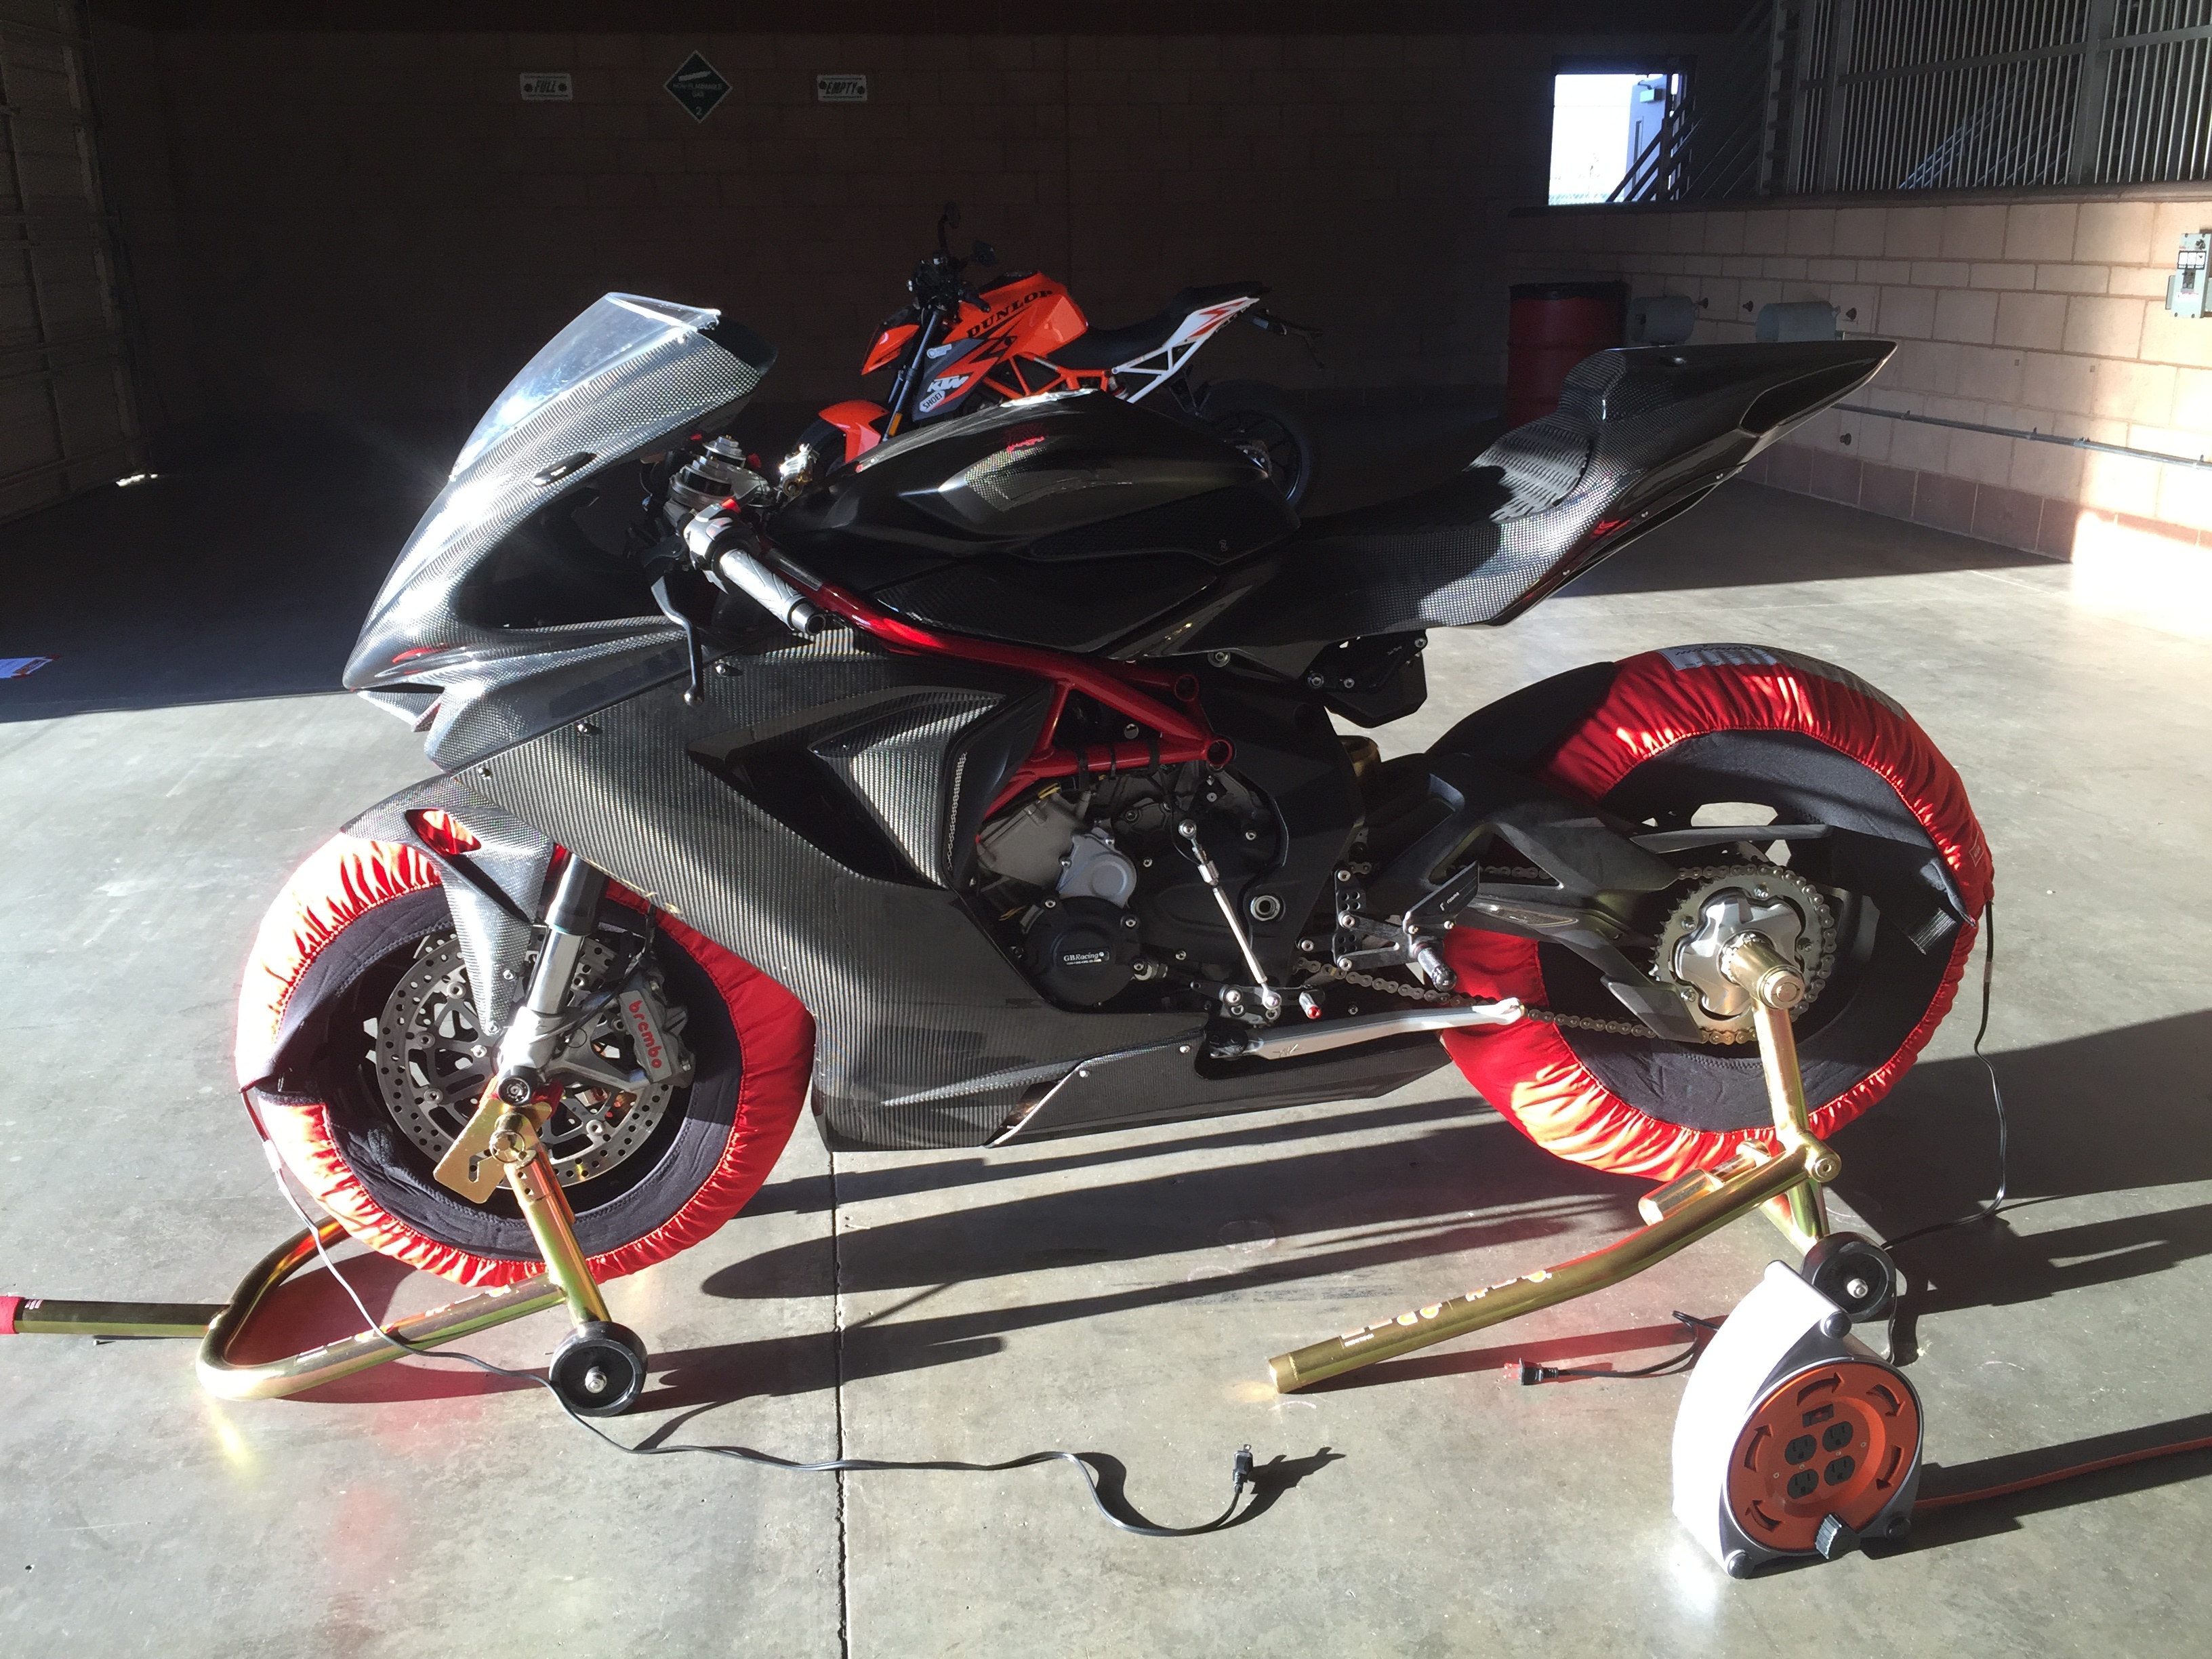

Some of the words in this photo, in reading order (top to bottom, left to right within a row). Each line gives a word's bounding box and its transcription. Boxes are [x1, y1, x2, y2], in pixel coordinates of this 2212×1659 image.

[534, 79, 556, 93] FULL
[825, 81, 858, 94] EMPTY
[695, 106, 703, 116] 2
[926, 375, 970, 393] KTM
[922, 393, 943, 410] SHOEI
[628, 1000, 662, 1069] brembo
